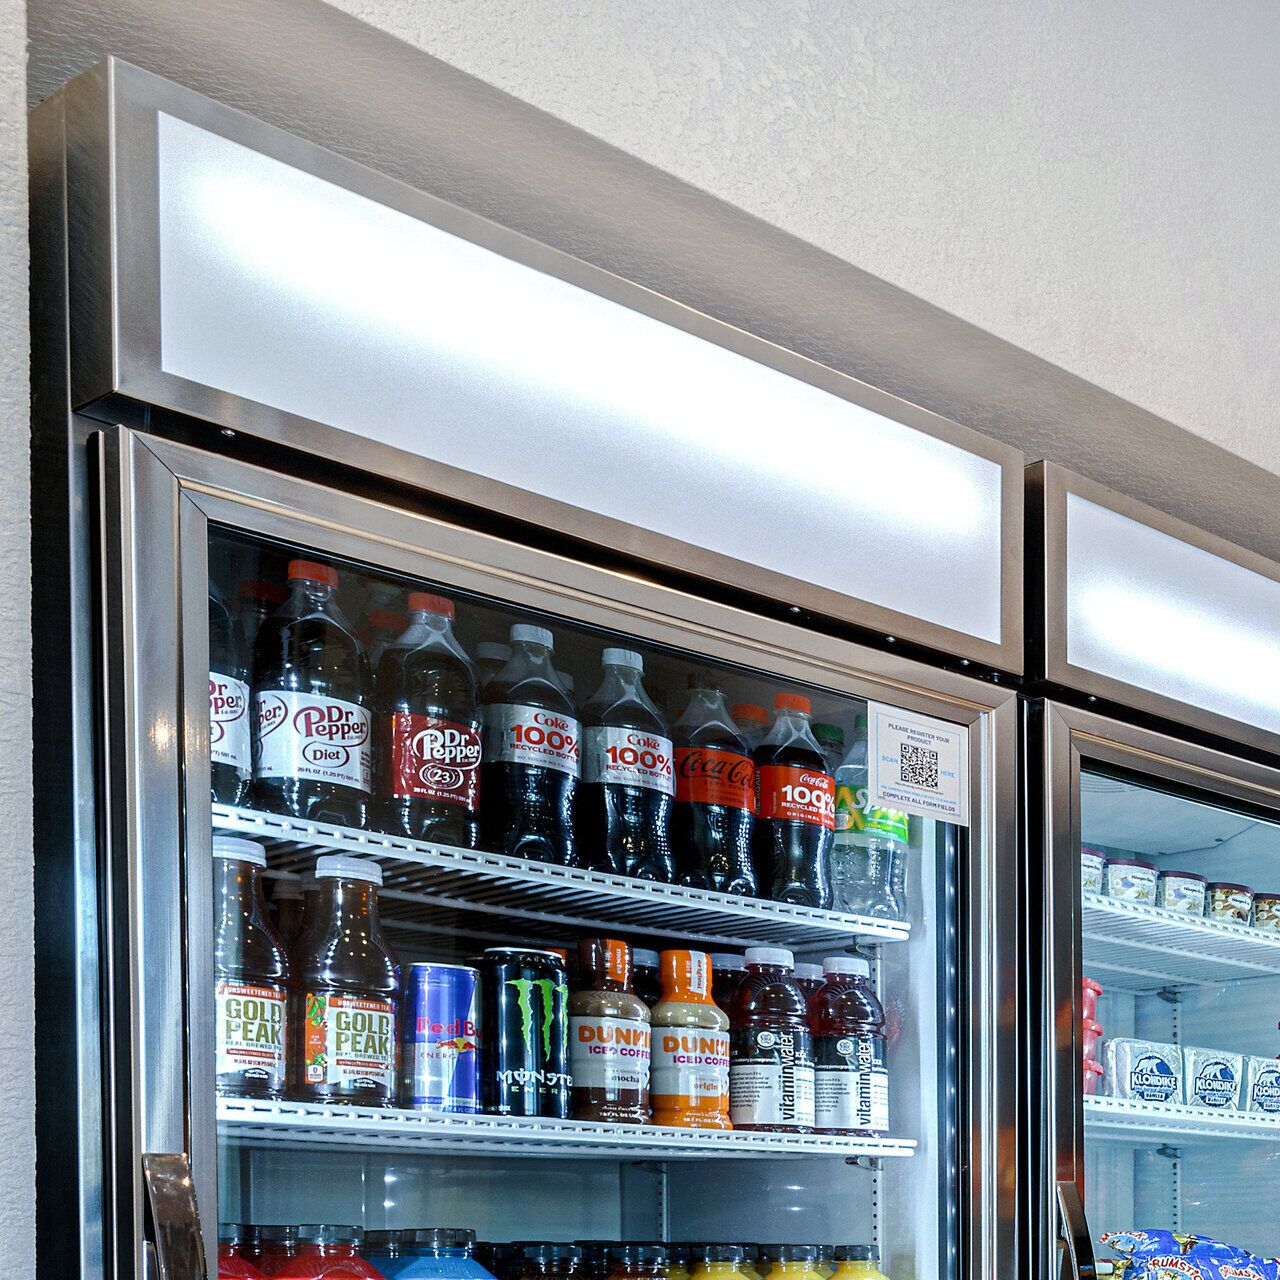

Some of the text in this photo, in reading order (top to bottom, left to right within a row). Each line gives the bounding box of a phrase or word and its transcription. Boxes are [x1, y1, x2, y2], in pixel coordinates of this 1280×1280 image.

[294, 706, 367, 741] Pepper
[326, 706, 354, 722] Dr
[533, 712, 569, 732] Coke
[445, 727, 469, 748] Dr
[510, 724, 580, 758] 100%
[627, 733, 660, 751] Coke
[888, 723, 950, 744] PLEASE REGISTER YOUR
[906, 736, 931, 746] PRODUCT
[313, 750, 340, 761] Diet
[413, 729, 480, 763] Pepper
[510, 743, 554, 757] RECYCLED
[605, 746, 672, 776] 100%
[881, 755, 898, 764] SCAN
[434, 771, 450, 782] 23
[940, 769, 955, 778] HERE
[882, 791, 911, 802] COMPLETE
[937, 803, 956, 813] FIELDS
[787, 811, 820, 822] ORIGINAL
[226, 998, 281, 1023] GOLD
[226, 1020, 281, 1045] PEAK
[336, 1011, 390, 1035] GOLD
[417, 1017, 459, 1035] Red
[336, 1031, 389, 1055] PEAK
[673, 1055, 703, 1063] ICED
[779, 1031, 794, 1122] vitaminwater
[856, 1036, 871, 1127] vitaminwater
[1130, 1072, 1178, 1091] KLONDIKE
[1195, 1077, 1237, 1095] KLONDIKE
